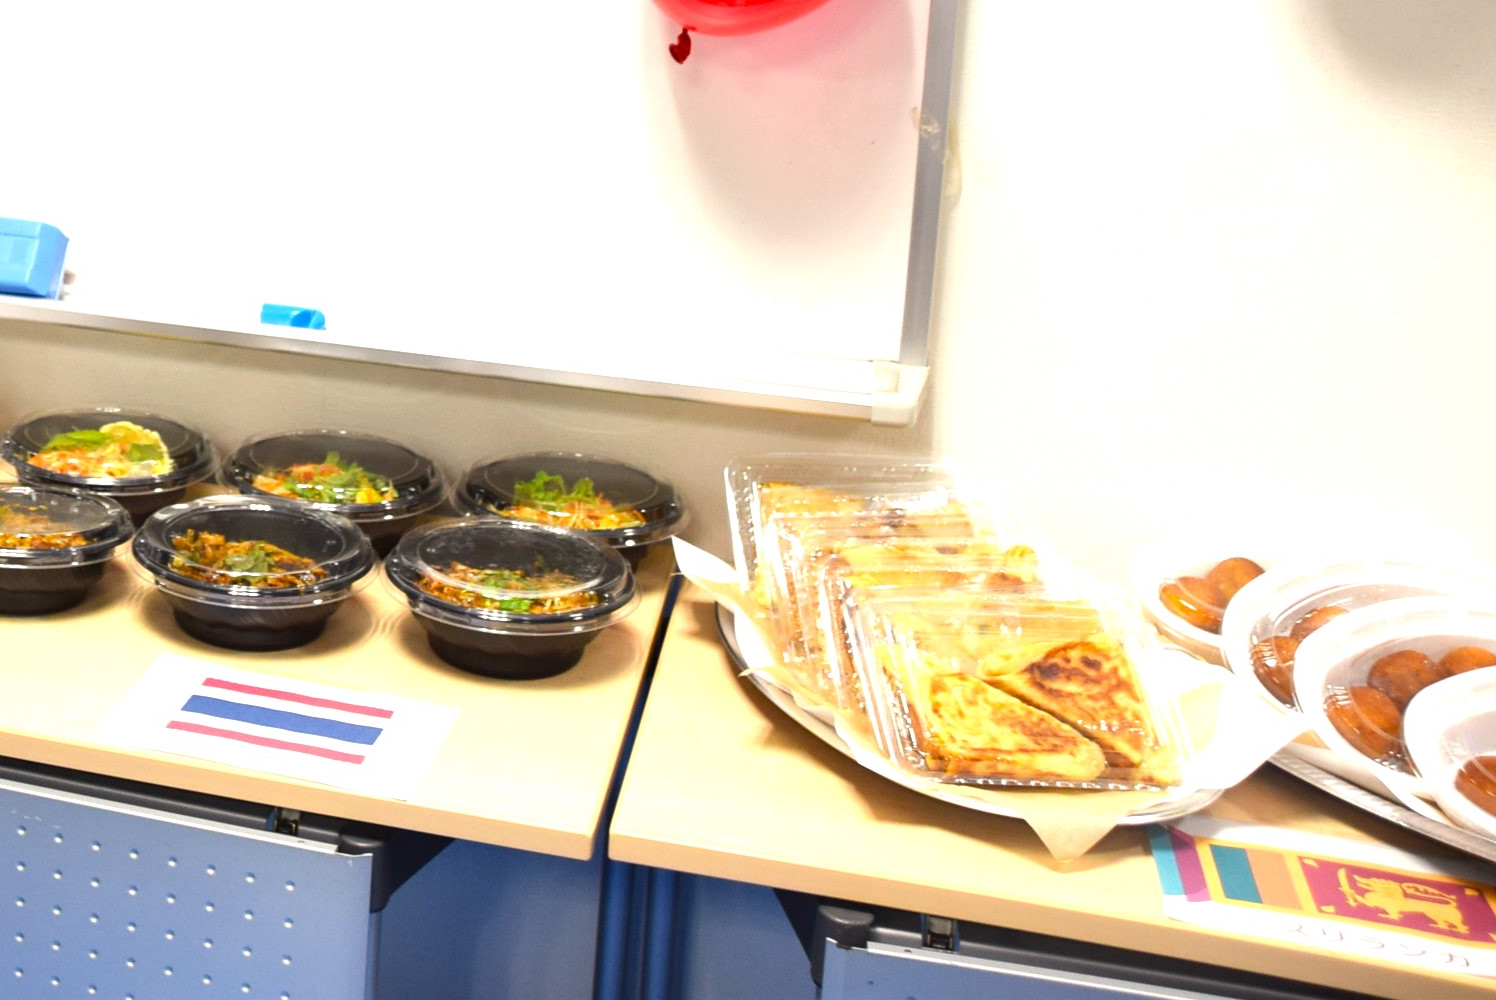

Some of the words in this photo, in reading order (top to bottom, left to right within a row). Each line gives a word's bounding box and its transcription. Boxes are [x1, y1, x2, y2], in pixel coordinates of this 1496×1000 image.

[1288, 923, 1470, 967] スリランカ
